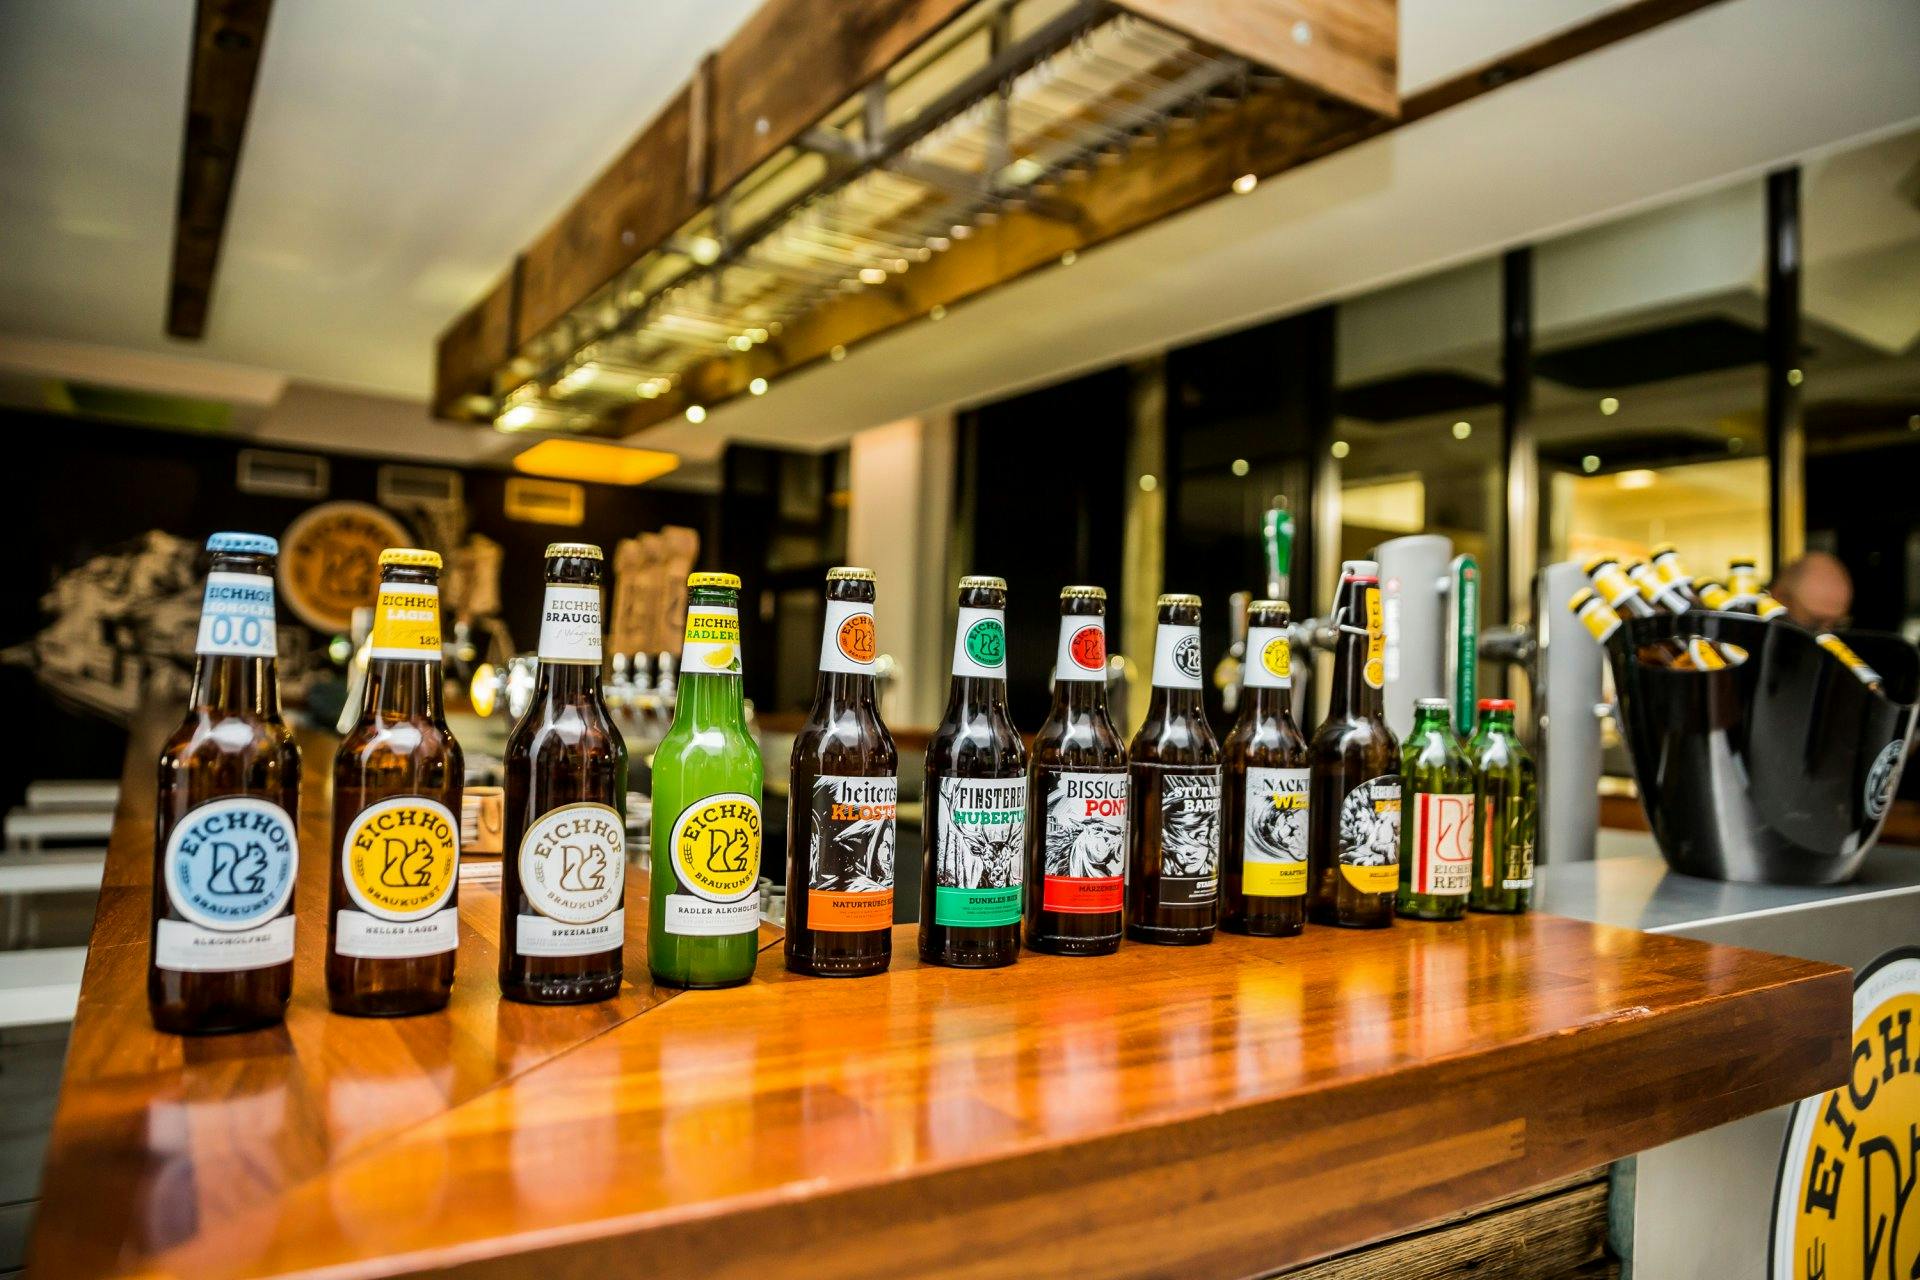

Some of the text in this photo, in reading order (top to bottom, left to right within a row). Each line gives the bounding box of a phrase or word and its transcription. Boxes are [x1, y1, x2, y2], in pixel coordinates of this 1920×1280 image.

[551, 600, 601, 612] EICHHO
[179, 811, 290, 858] EICHHOF
[354, 810, 453, 851] EICHHOF
[683, 804, 760, 842] EICHHOF
[534, 818, 623, 860] EICHHOF
[694, 869, 754, 890] BRAUKUNST
[192, 891, 275, 916] BRAUKUNST
[367, 885, 441, 906] BRAUKUNST
[546, 889, 613, 910] BRAUKUNST
[678, 906, 713, 915] RADLER
[551, 925, 609, 937] SPEZIALBIER
[1804, 1008, 1920, 1220] EICH
